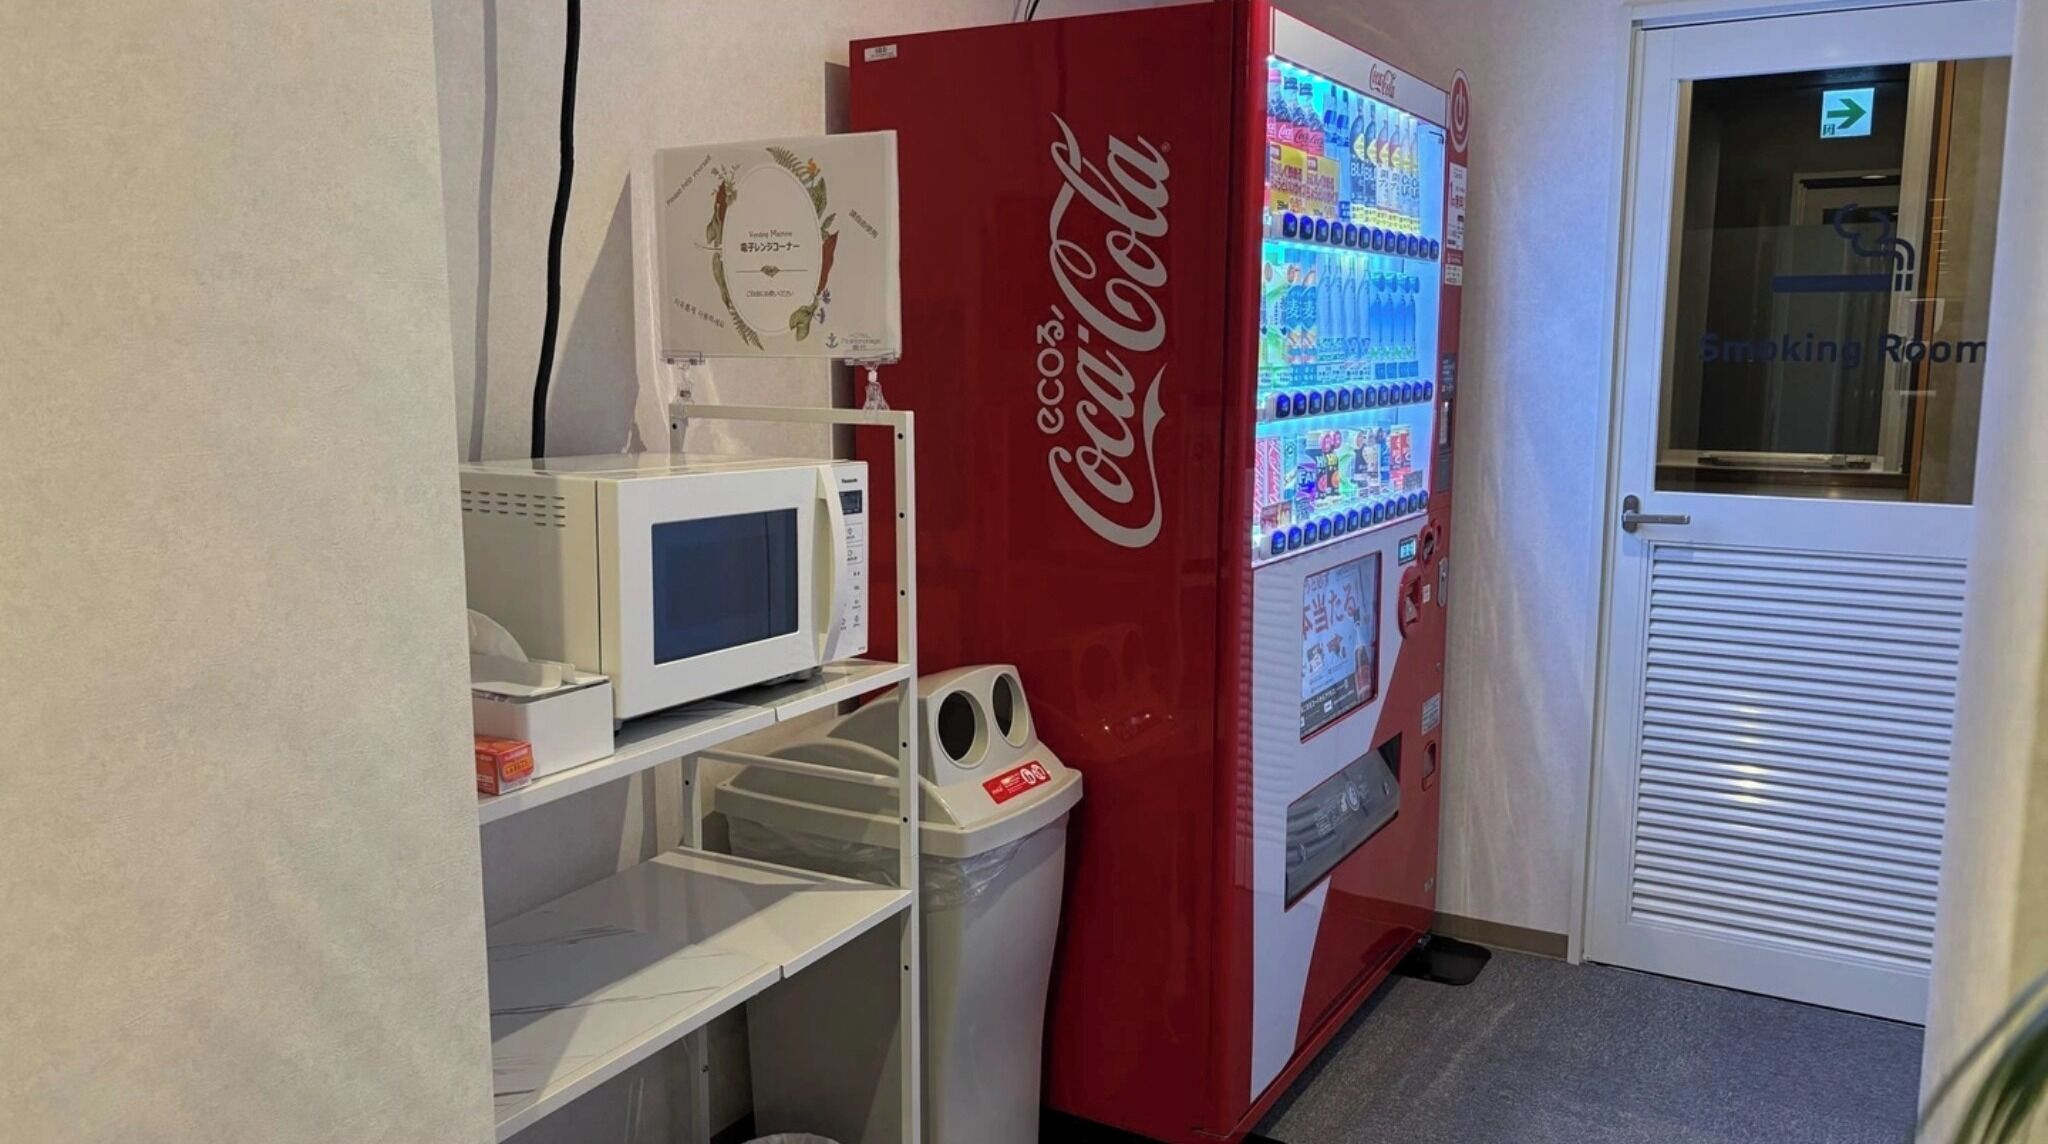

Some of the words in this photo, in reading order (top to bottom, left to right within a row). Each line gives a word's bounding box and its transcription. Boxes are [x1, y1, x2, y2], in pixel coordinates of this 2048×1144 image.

[740, 242, 800, 253] 電子レンジコーナー
[1047, 111, 1171, 548] Coca-Cola
[1700, 332, 1863, 369] Smoking
[1878, 333, 1987, 363] Room
